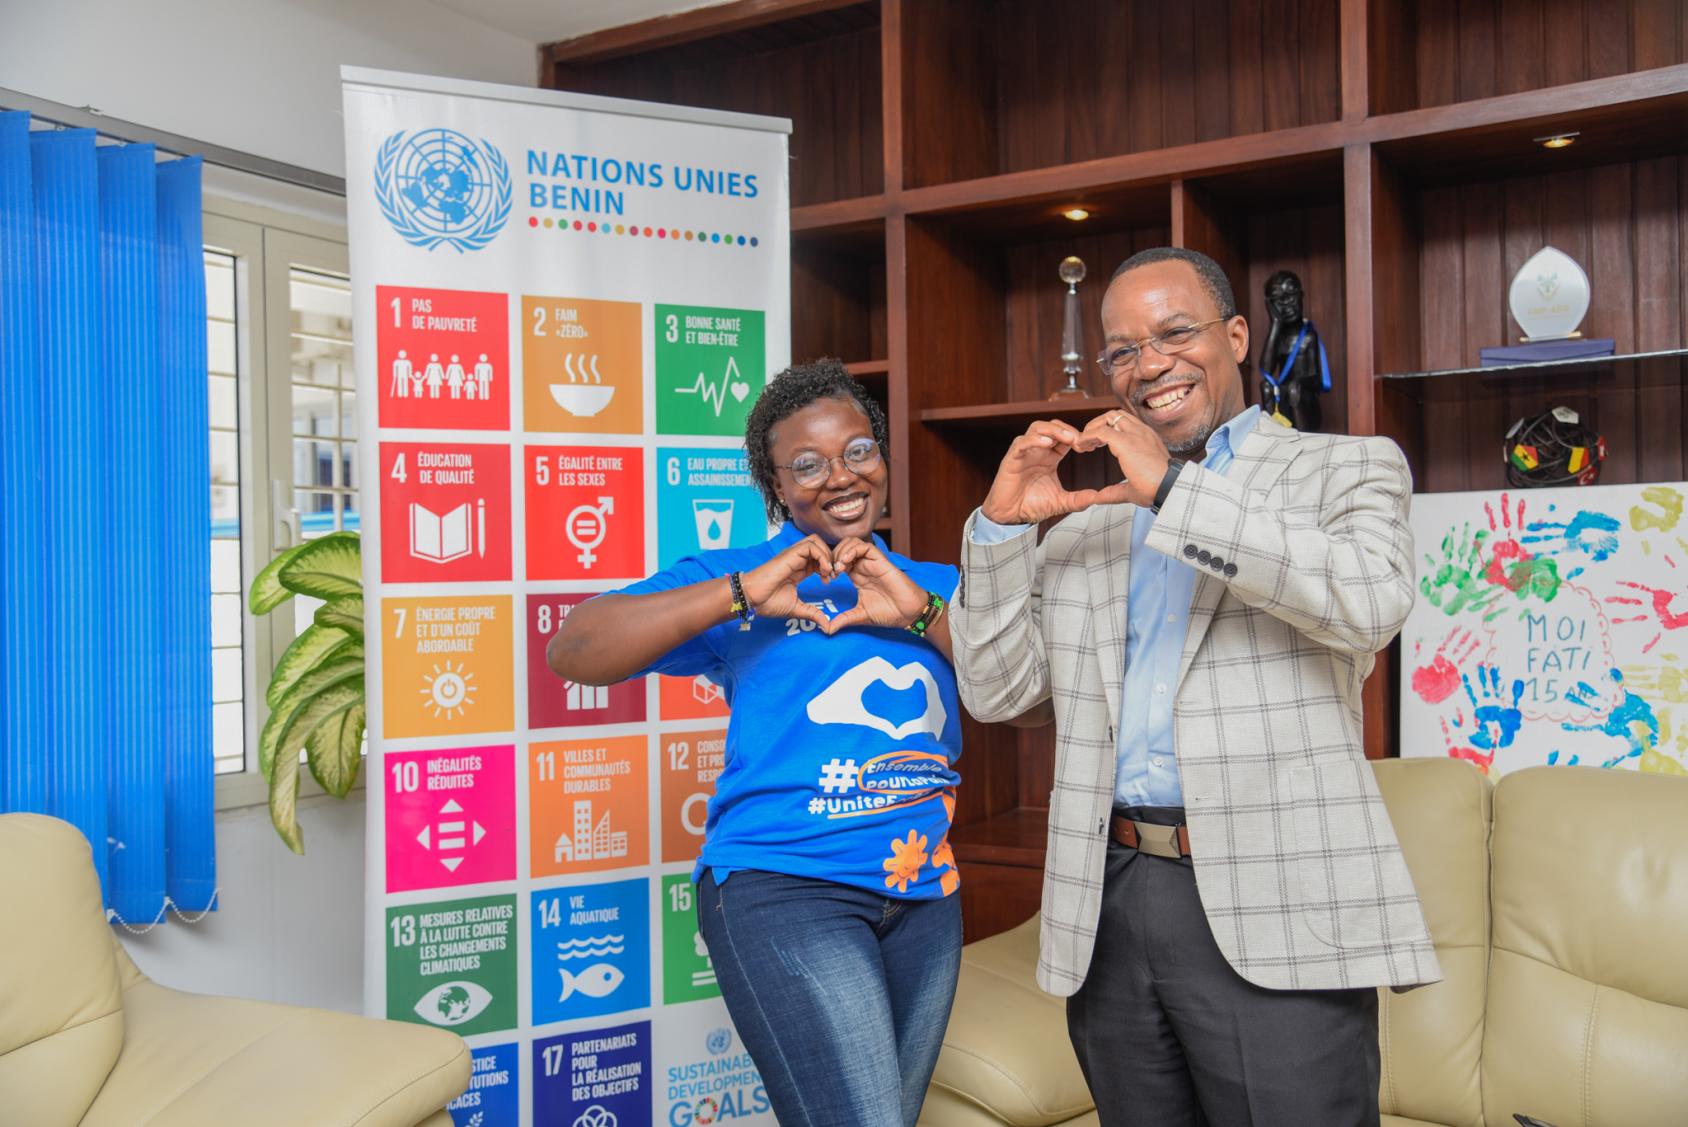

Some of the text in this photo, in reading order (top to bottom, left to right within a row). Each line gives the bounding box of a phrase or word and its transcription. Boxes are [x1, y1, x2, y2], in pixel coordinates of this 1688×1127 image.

[528, 150, 758, 198] NATIONS UNIES
[529, 182, 623, 215] BENIN
[391, 297, 401, 329] 1
[411, 298, 432, 313] PAS
[555, 308, 577, 321] FAIM
[412, 315, 478, 332] DE PAUVRETÉ
[533, 307, 547, 337] 2
[665, 314, 679, 343] 3
[685, 315, 741, 332] BONNE SANTÉ
[685, 331, 739, 347] ET BIEN-ÊTRE
[391, 452, 407, 483] 4
[417, 450, 472, 467] ÉDUCATION
[535, 455, 550, 486] 5
[558, 454, 623, 471] ÉGALITÉ ENTRE
[687, 457, 705, 471] EAU
[706, 457, 737, 471] PROPRE
[419, 468, 475, 485] DE QUALITÉ
[559, 473, 606, 486] LES SEXES
[667, 456, 681, 486] 6
[392, 607, 407, 639] 7
[415, 605, 497, 622] ÉNERGIE PROPRE
[537, 604, 552, 634] 8
[416, 621, 481, 638] ET D'UN COÛT
[1527, 613, 1586, 642] MOI
[416, 638, 474, 655] ABORDABLE
[1527, 647, 1592, 673] FATI
[1525, 677, 1558, 703] 15
[427, 754, 482, 774] INÉGALITÉS
[536, 751, 555, 782] 11
[563, 748, 607, 763] VILLES ET
[667, 741, 689, 771] 12
[697, 755, 708, 768] ET
[391, 760, 419, 794] 10
[563, 759, 631, 779] COMMUNAUTÉS
[427, 773, 475, 791] RÉDUITES
[563, 777, 612, 795] DURABLES
[569, 895, 585, 909] VIE
[668, 882, 692, 912] 15
[420, 904, 513, 928] MESURES RELATIVES
[538, 897, 561, 929] 14
[569, 906, 620, 926] AQUATIQUE
[390, 915, 416, 947] 13
[420, 921, 508, 945] À LA LUTTE CONTRE
[420, 937, 507, 960] LES CHANGEMENTS
[420, 955, 481, 976] CLIMATIQUES
[571, 1032, 637, 1057] PARTENARIATS
[542, 1043, 564, 1077] 17
[571, 1054, 598, 1071] POUR
[668, 1054, 751, 1083] SUSTAINAB
[571, 1061, 642, 1087] LA RÉALISATION
[571, 1076, 640, 1102] DES OBJECTIFS
[669, 1085, 770, 1127] GOALS
